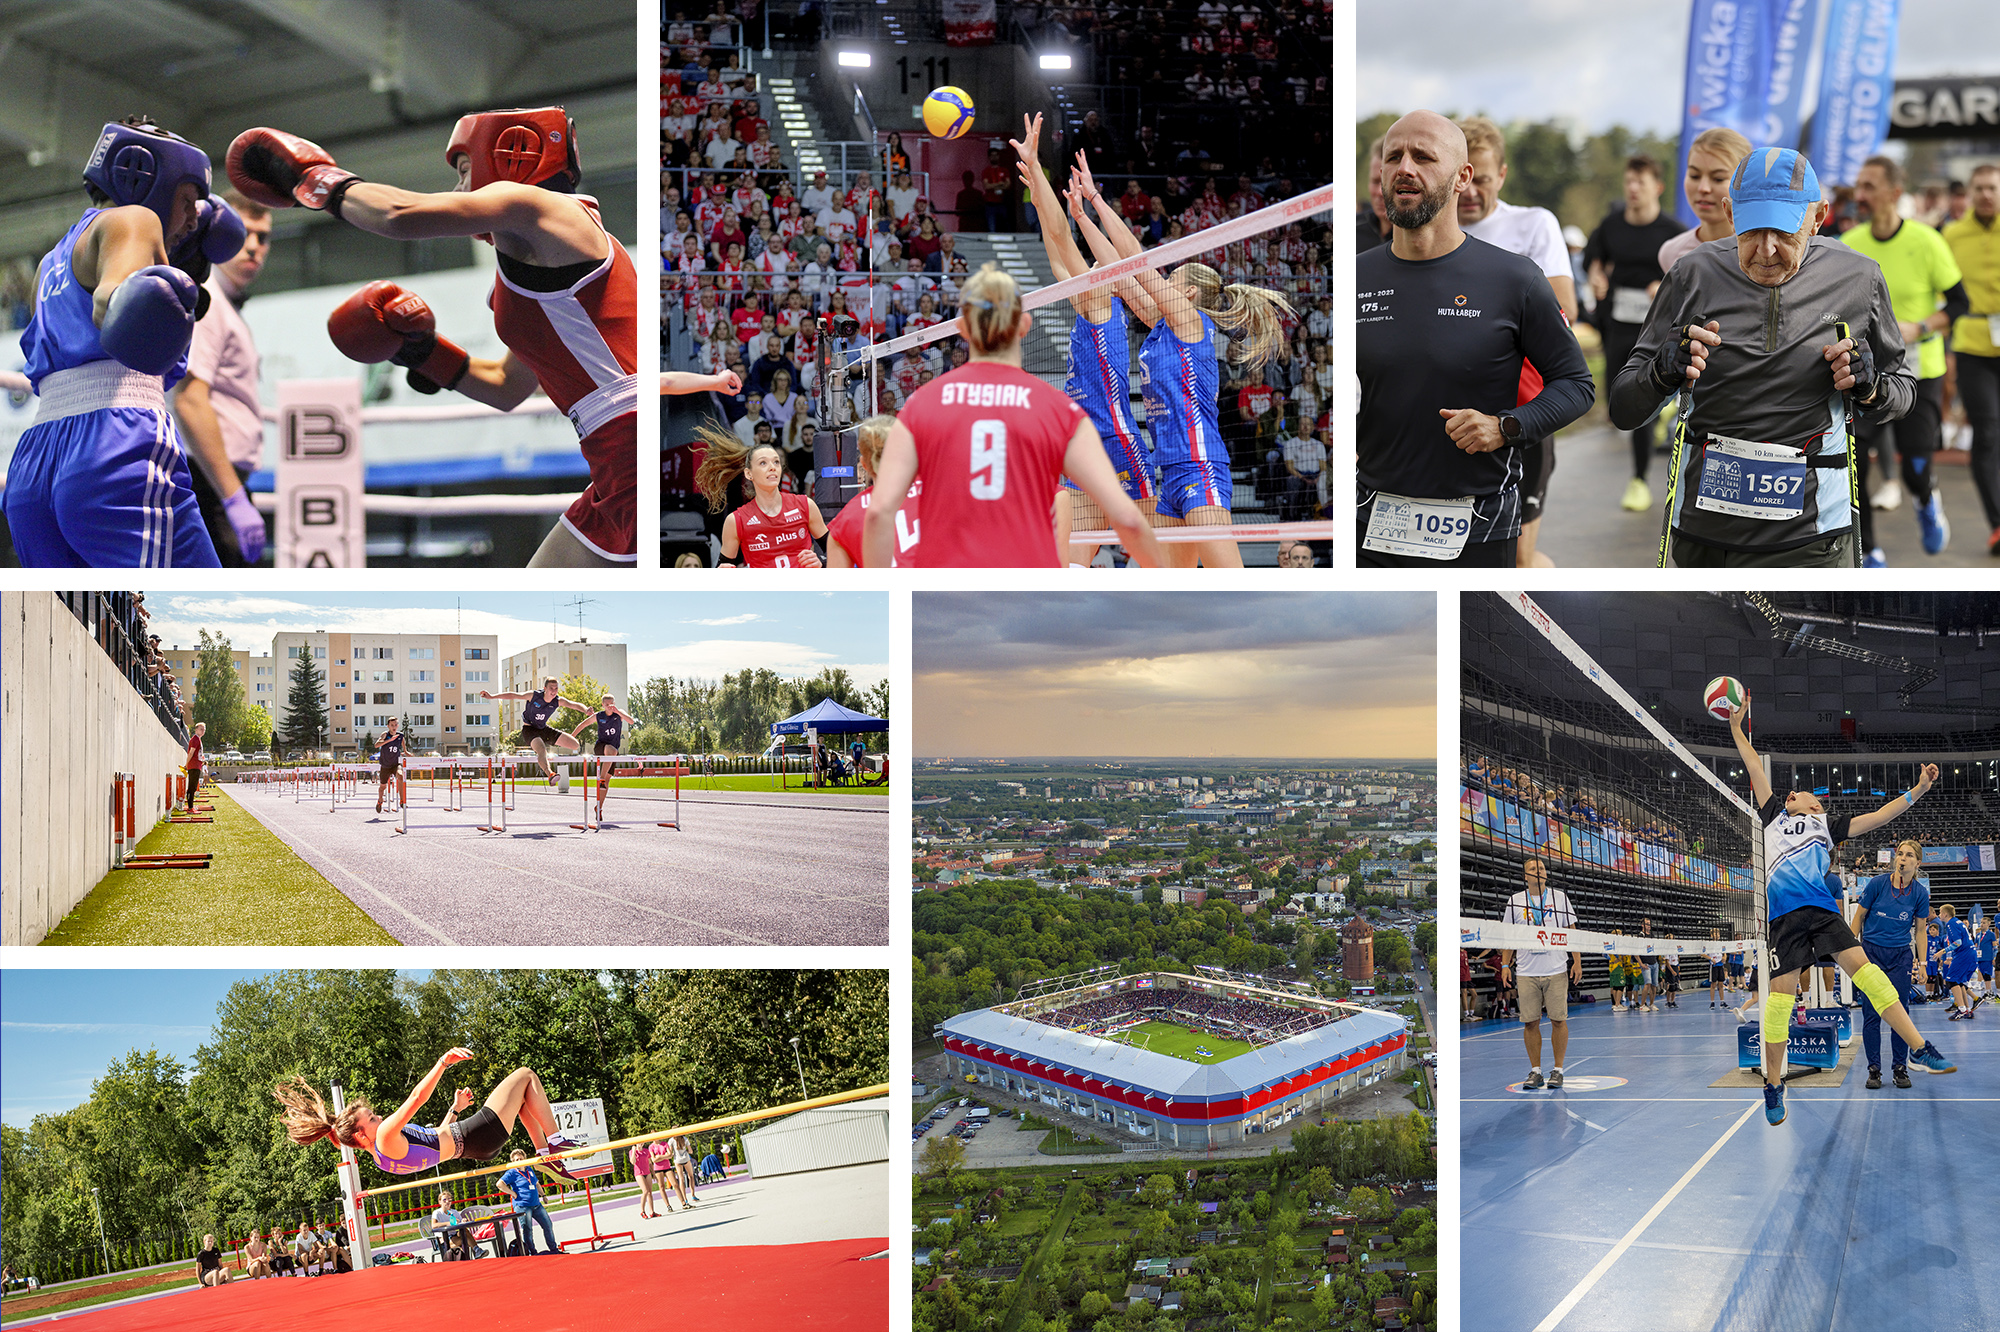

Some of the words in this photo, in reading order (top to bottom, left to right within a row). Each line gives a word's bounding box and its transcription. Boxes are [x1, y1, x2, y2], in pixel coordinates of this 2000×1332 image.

[1377, 289, 1395, 297] 2023
[1361, 302, 1378, 313] 175
[1437, 308, 1455, 316] HUTA
[1456, 308, 1482, 318] ŁABĘDY
[941, 382, 1031, 409] STYSIAK
[970, 419, 1006, 500] 9
[1746, 473, 1803, 495] 1567
[1753, 496, 1785, 505] ANDRZEJ
[1415, 513, 1469, 536] 1059
[775, 532, 798, 545] plus
[1423, 536, 1448, 546] MACIEJ
[749, 542, 770, 551] ORLEN
[1817, 712, 1833, 723] 3-17
[604, 727, 616, 736] 19
[388, 745, 398, 753] 18
[554, 1110, 583, 1131] 127
[591, 1108, 599, 1126] 1
